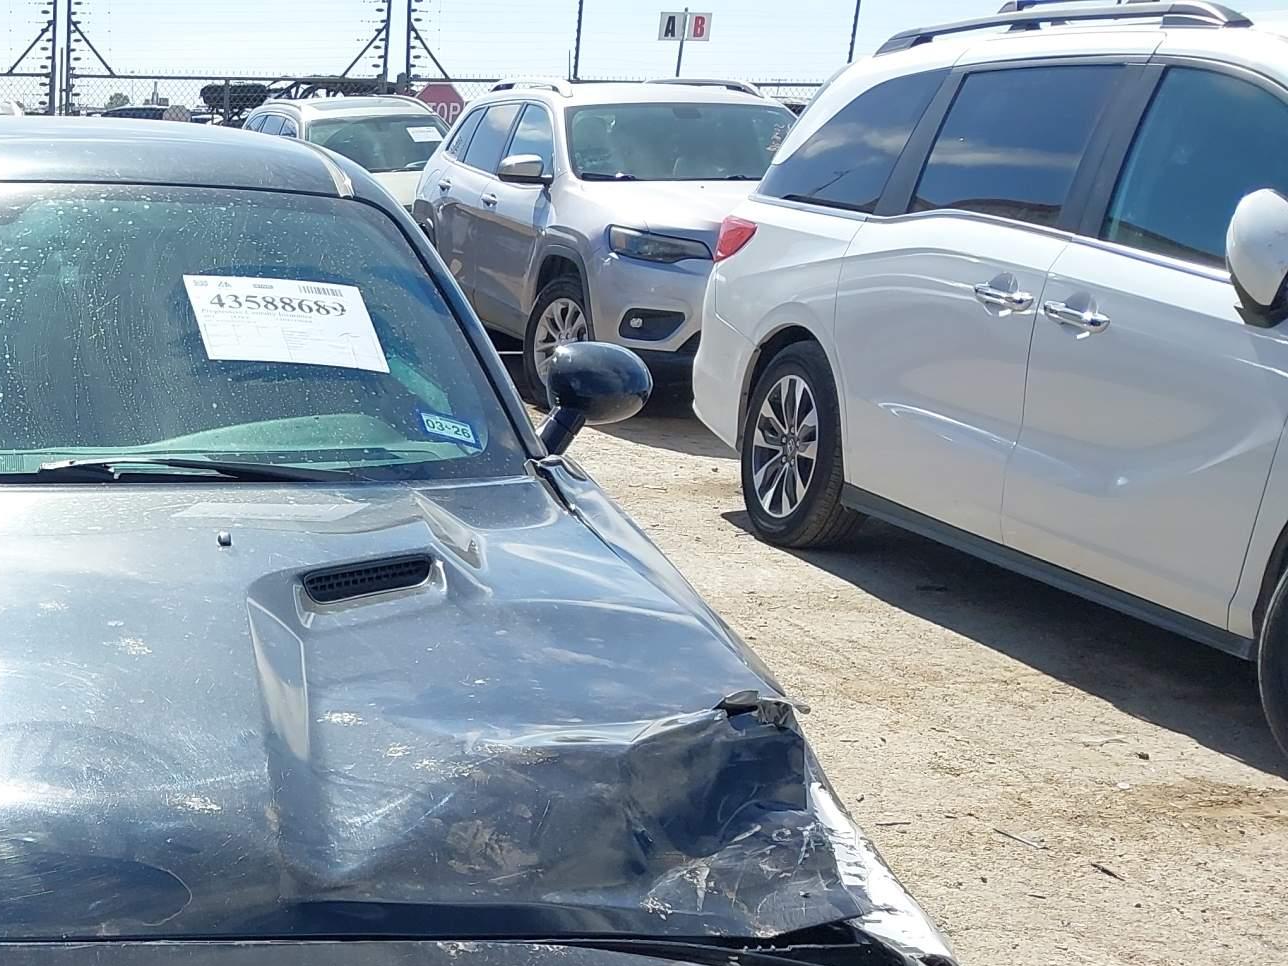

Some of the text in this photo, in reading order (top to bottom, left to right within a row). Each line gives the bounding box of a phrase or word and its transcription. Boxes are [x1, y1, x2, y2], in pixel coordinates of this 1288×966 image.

[664, 16, 675, 37] A
[693, 16, 705, 37] B
[427, 102, 461, 124] TOP
[426, 419, 471, 438] 03-26
